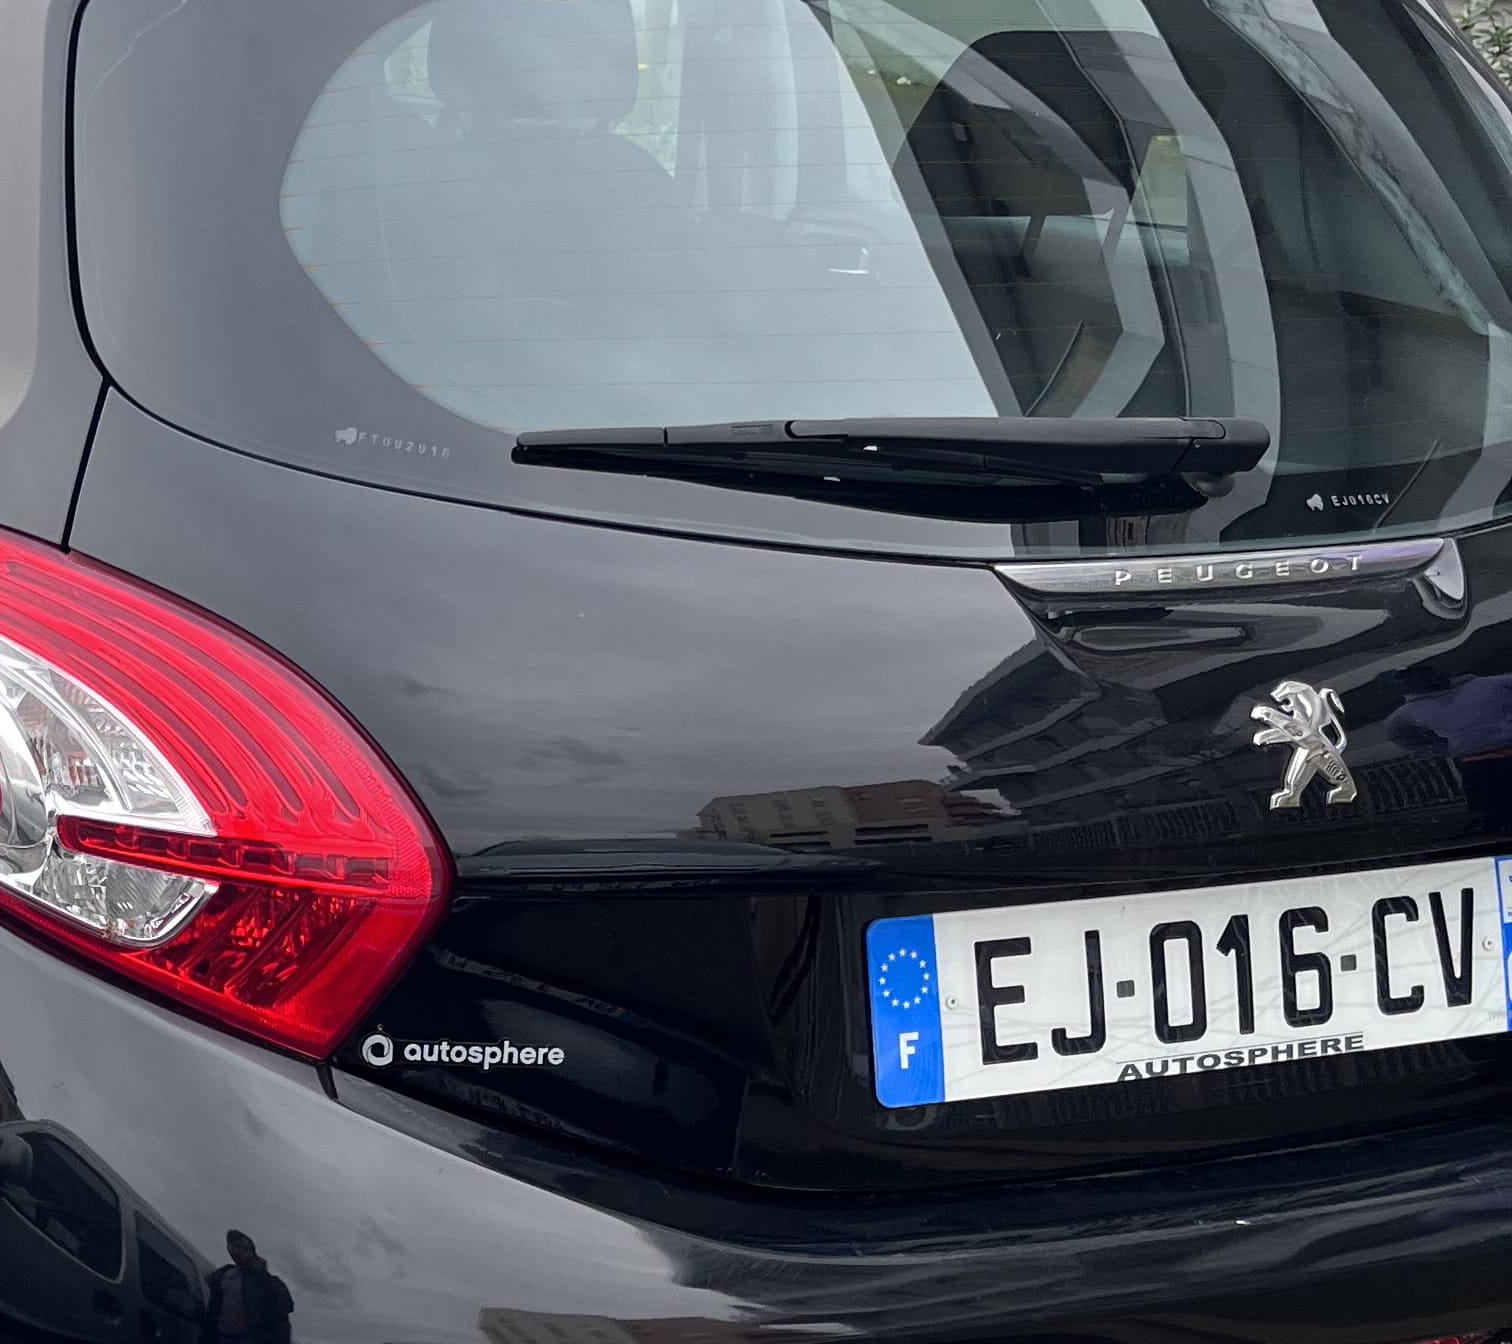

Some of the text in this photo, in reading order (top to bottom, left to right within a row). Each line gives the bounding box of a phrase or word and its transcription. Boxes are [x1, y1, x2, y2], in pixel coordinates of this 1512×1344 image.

[1331, 493, 1390, 507] EJ016CV
[1115, 555, 1363, 586] PEUGEOT
[403, 1040, 565, 1070] autosphere
[899, 1031, 919, 1069] F
[1116, 1034, 1365, 1081] AUTOSPHERE
